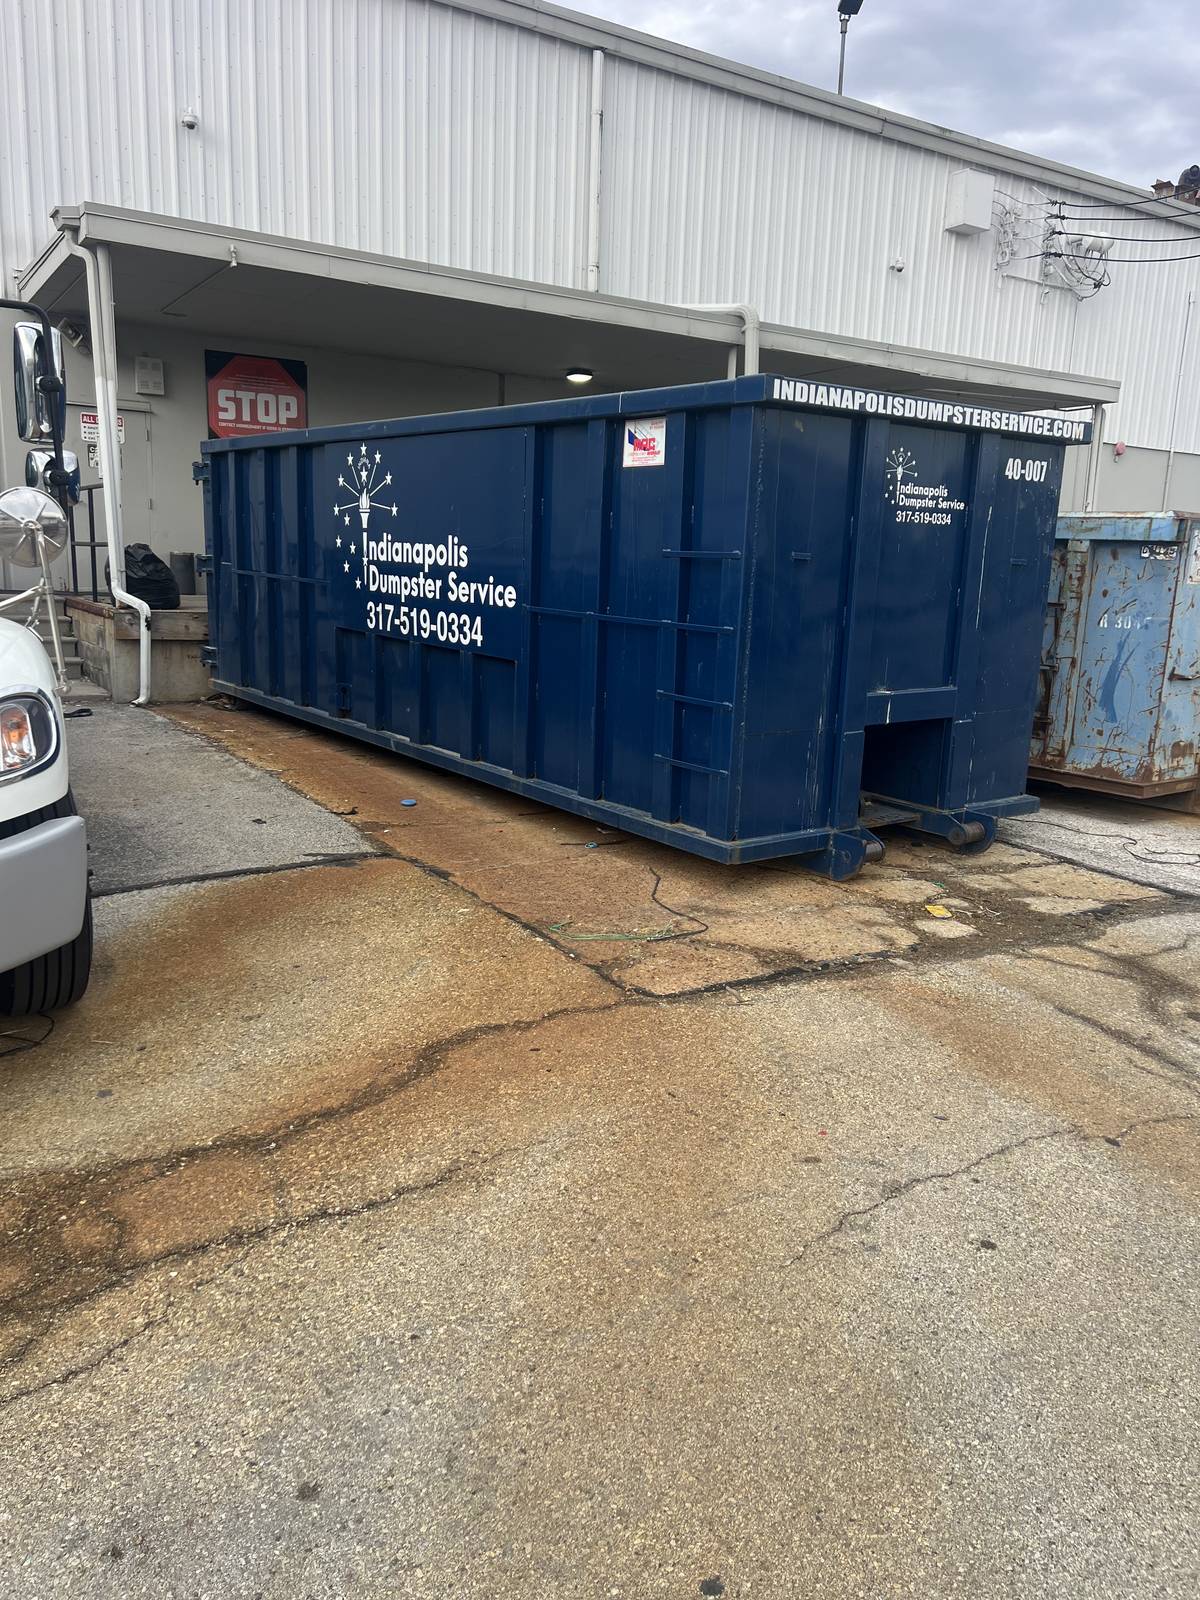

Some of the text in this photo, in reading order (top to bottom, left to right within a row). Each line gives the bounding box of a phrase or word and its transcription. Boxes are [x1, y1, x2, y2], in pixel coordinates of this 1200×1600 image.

[82, 415, 96, 424] ALL
[217, 388, 298, 425] STOP
[773, 379, 1085, 440] INDIANAPOLISDUMPSTERSERVICE.COM
[1005, 458, 1048, 482] 40-007
[897, 481, 949, 499] Indianapolis
[899, 494, 965, 510] Dumpster Service
[896, 511, 951, 525] 317-519-0334
[363, 532, 468, 572] Indianapolis
[369, 565, 517, 608] Dumpster Service
[366, 601, 483, 647] 317-519-0334
